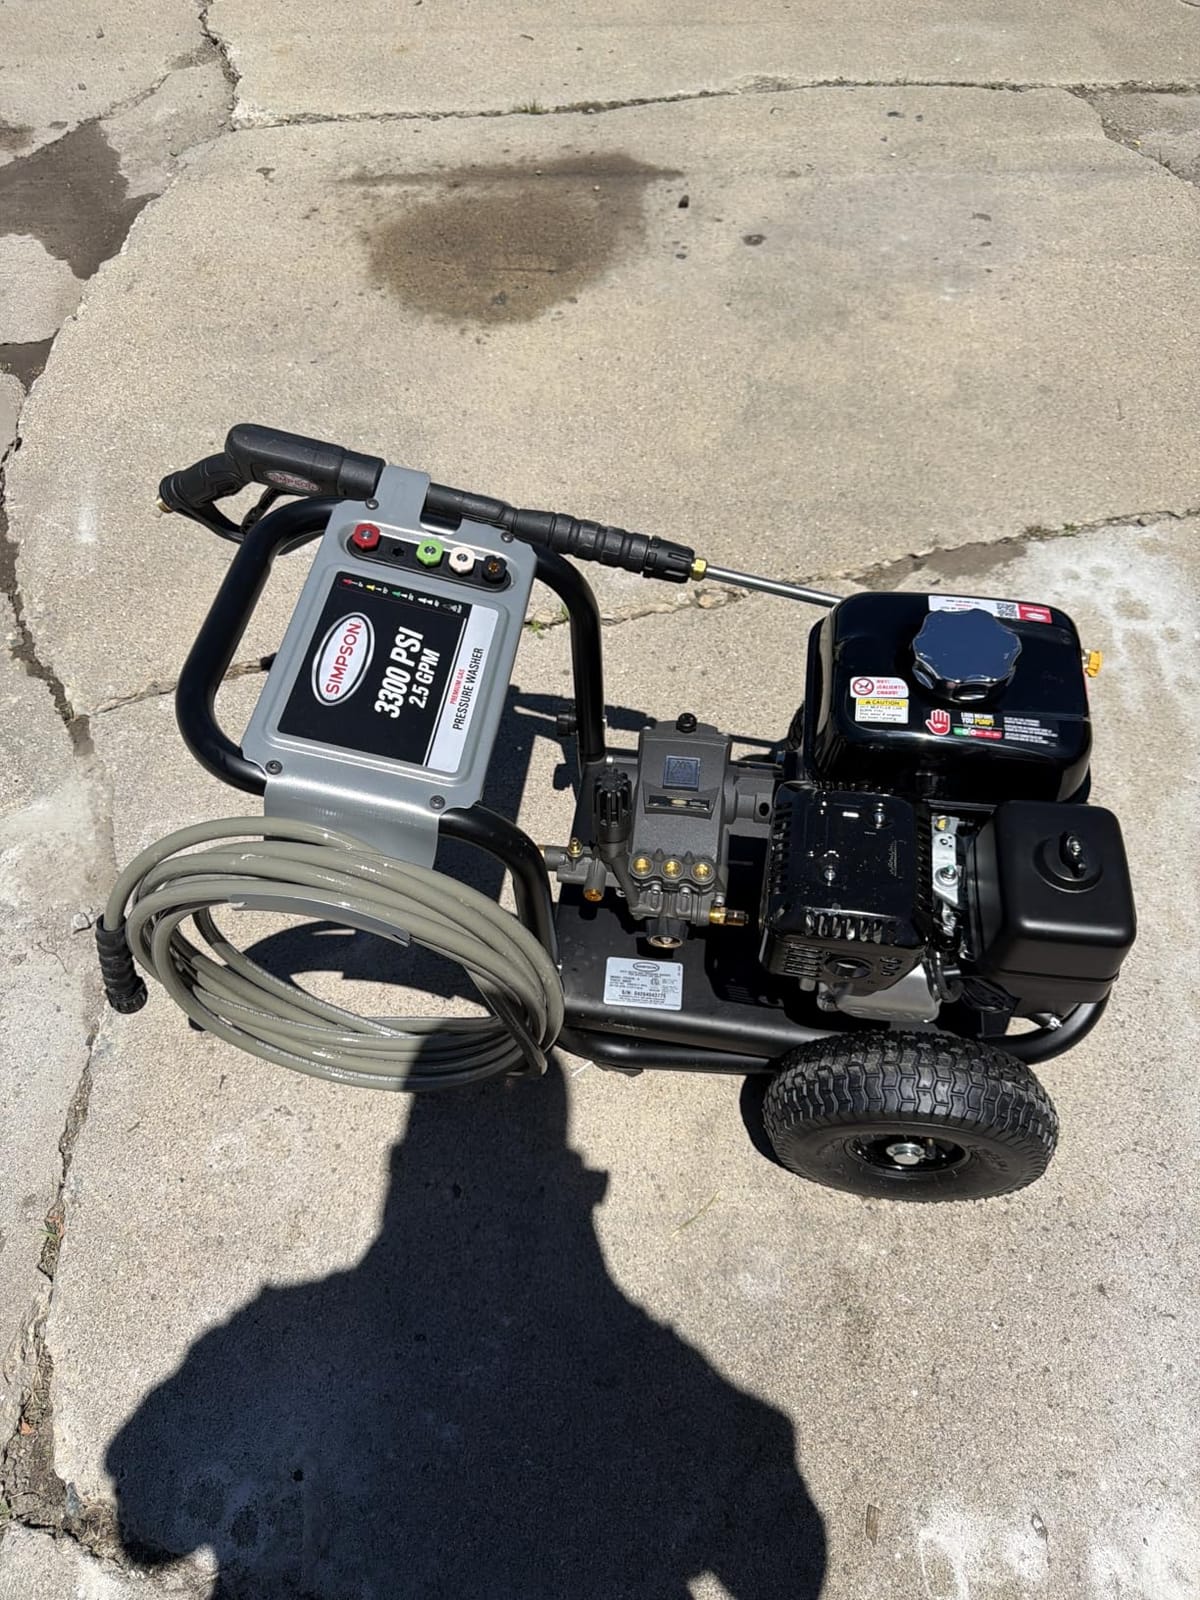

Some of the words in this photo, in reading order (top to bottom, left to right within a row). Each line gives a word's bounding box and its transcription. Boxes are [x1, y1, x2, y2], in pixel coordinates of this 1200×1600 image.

[325, 623, 362, 695] SIMPSON
[390, 626, 424, 667] PSI
[415, 648, 440, 684] GPM
[374, 666, 411, 718] 3300
[408, 683, 430, 709] 2.5
[449, 680, 461, 704] PREMIUM
[452, 685, 474, 730] PRESSURE
[465, 647, 484, 684] WASHER
